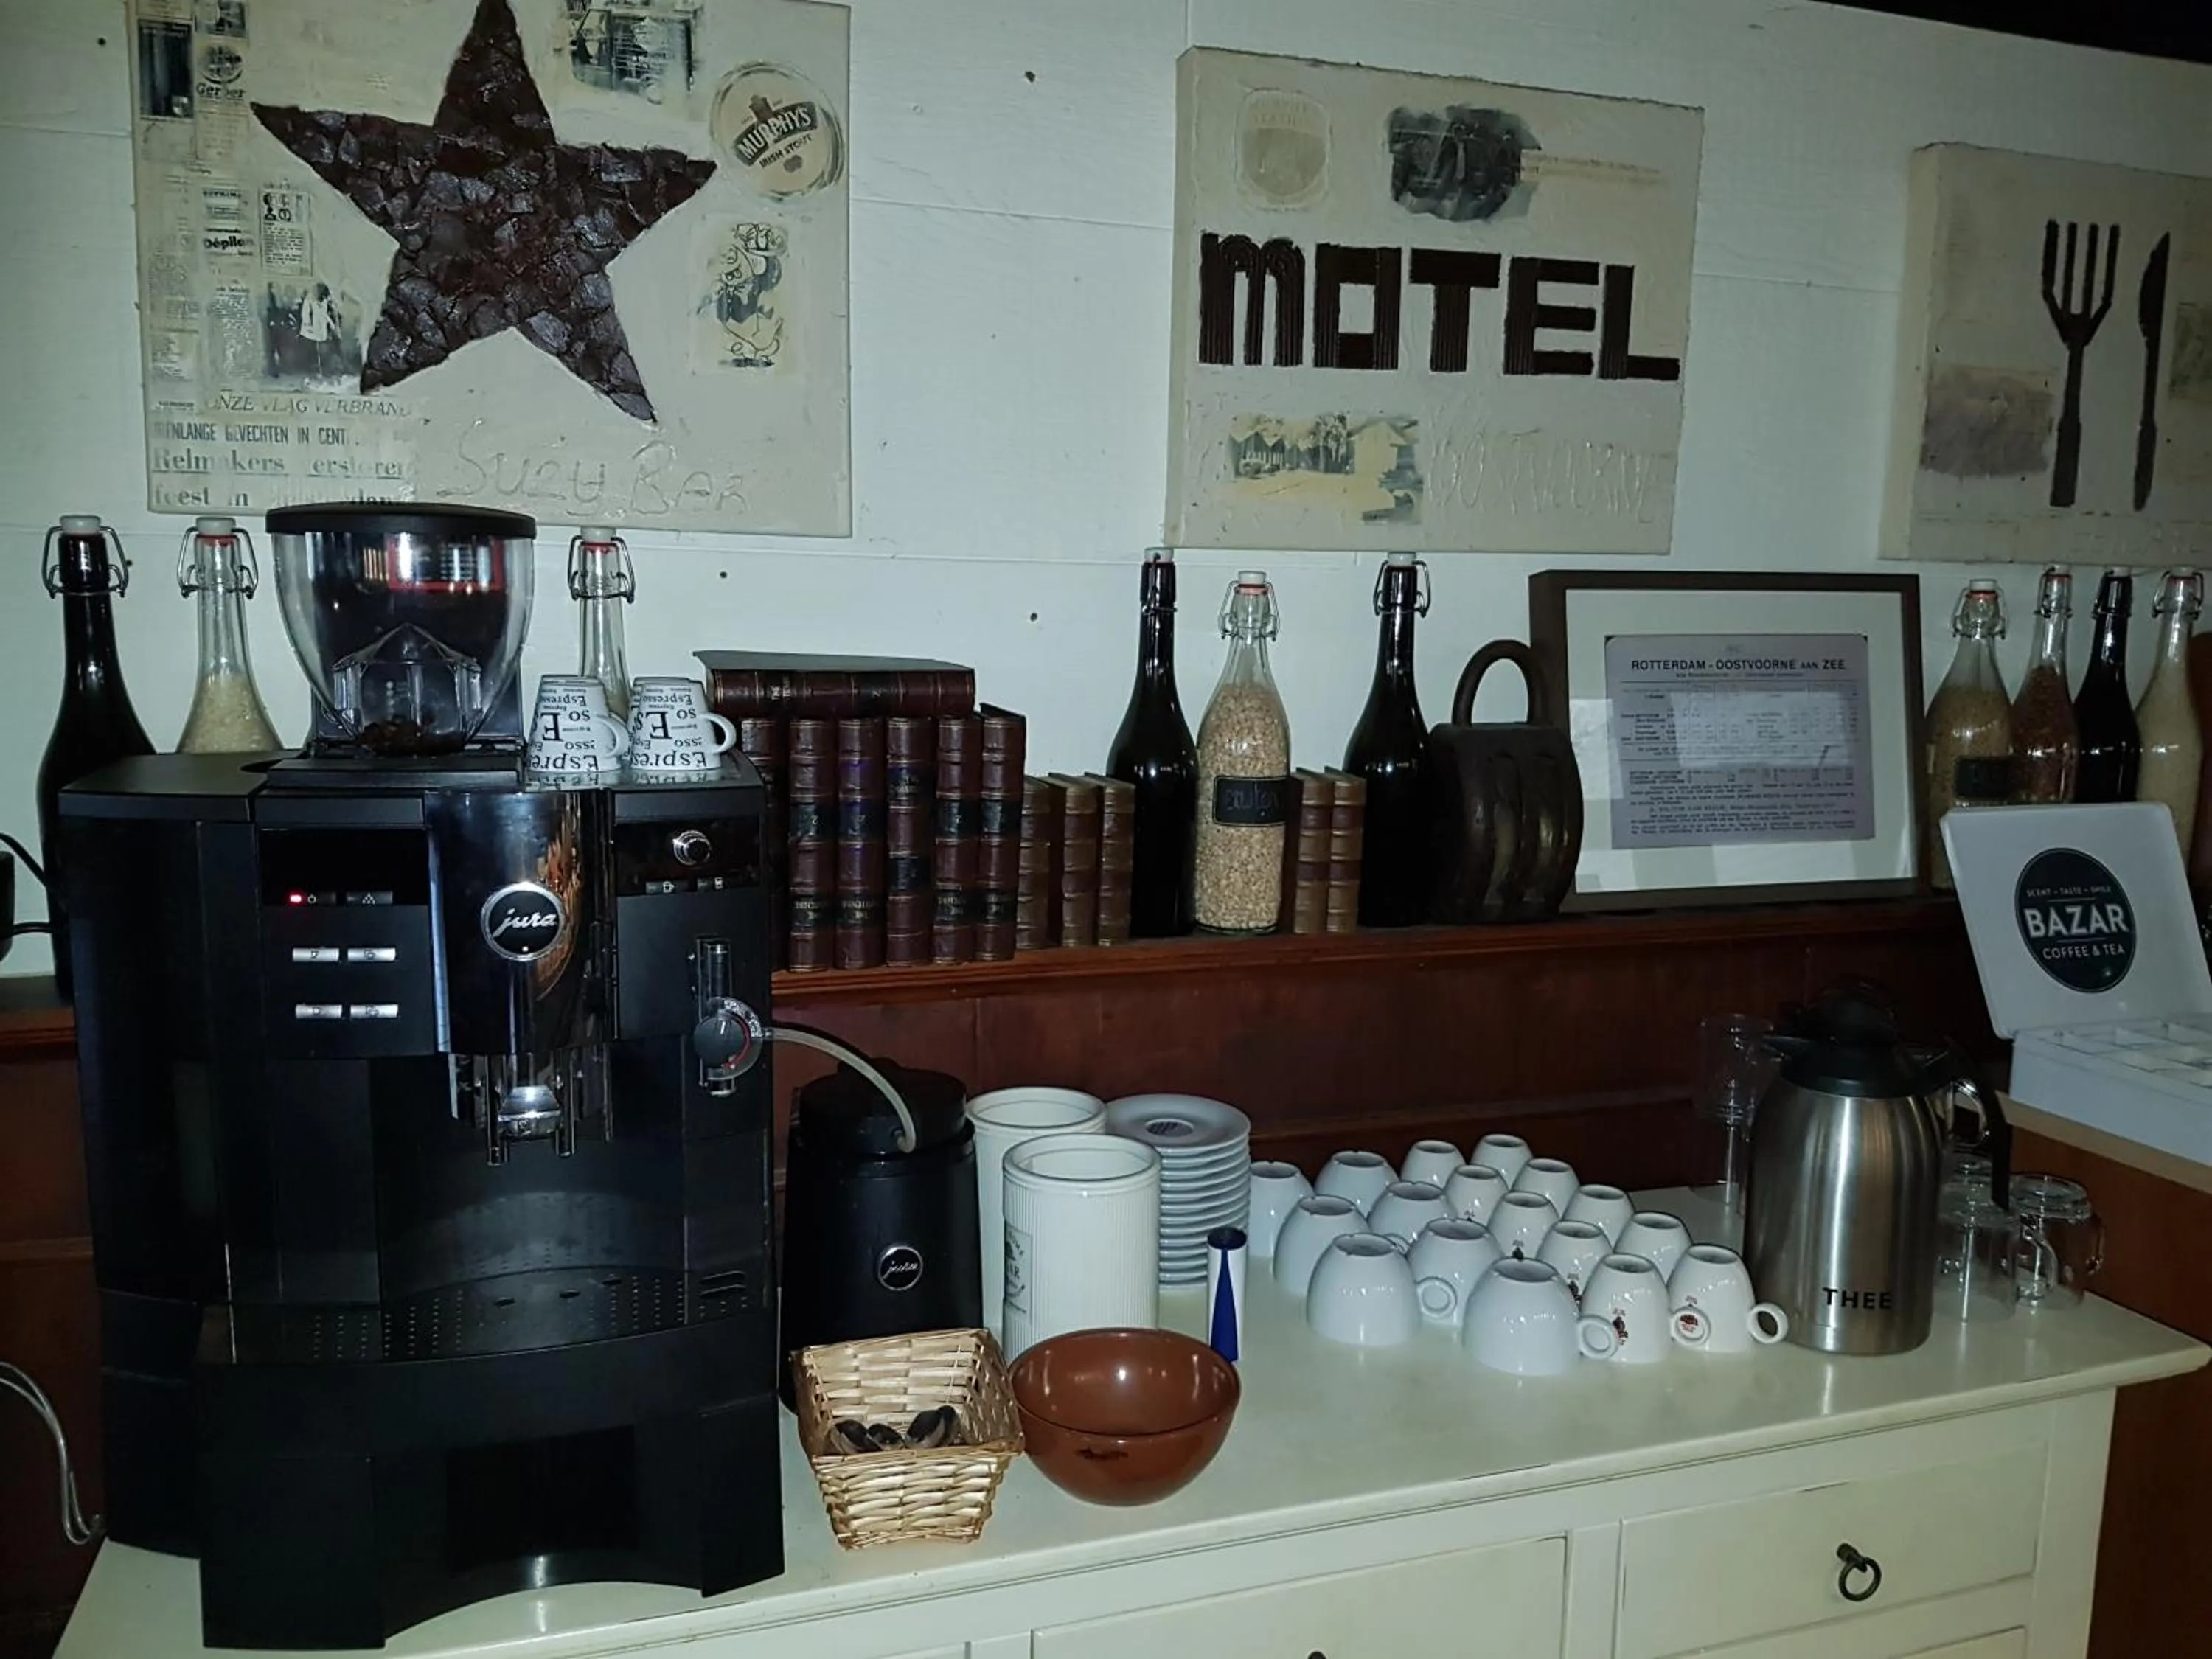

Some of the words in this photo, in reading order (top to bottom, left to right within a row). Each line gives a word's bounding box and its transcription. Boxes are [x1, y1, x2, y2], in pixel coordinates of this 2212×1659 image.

[1198, 229, 1680, 380] MOTEL
[298, 427, 309, 444] IN
[1631, 660, 1705, 671] ROTTERDAM
[1716, 659, 1796, 671] OOSTVOORNE
[1822, 659, 1846, 670] ZEE
[493, 908, 557, 939] jura
[2023, 904, 2129, 938] BAZAR
[2043, 945, 2090, 959] COFFEE
[2093, 945, 2101, 956] &
[2103, 944, 2124, 956] TEA
[1822, 1287, 1892, 1309] THEE
